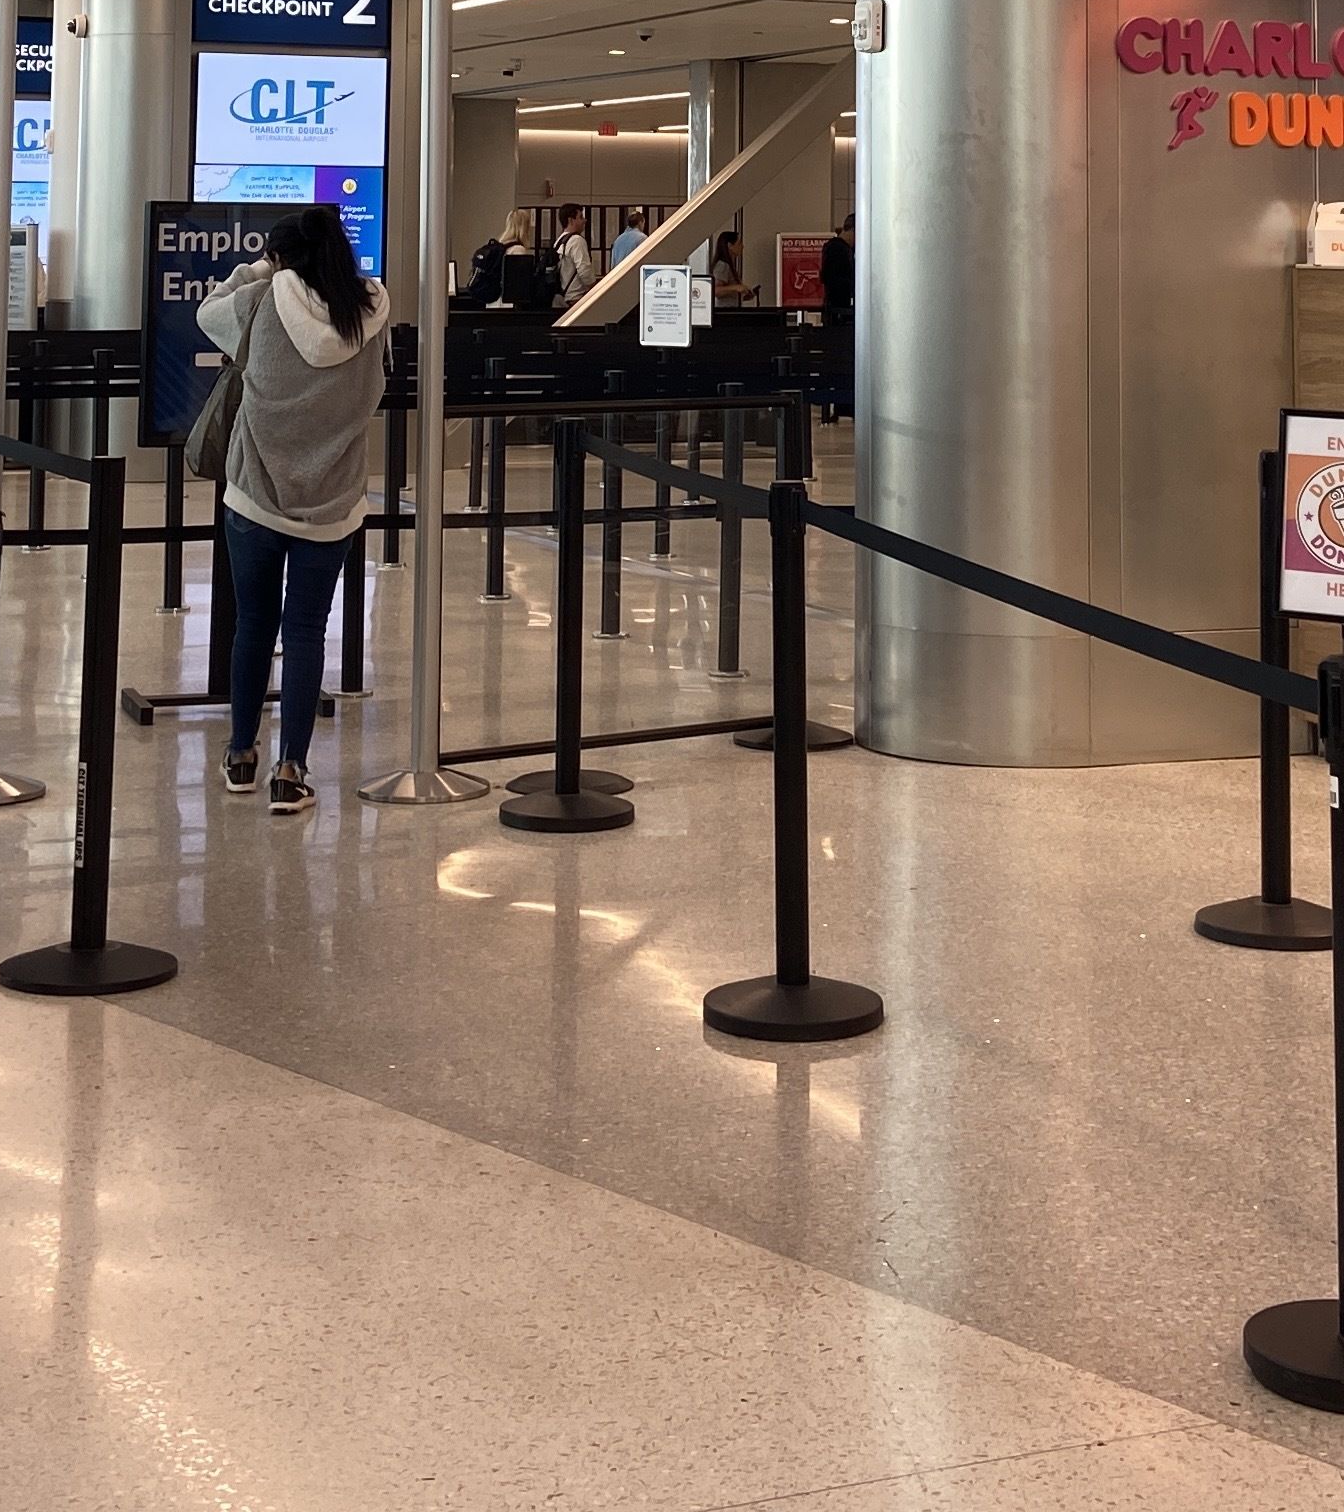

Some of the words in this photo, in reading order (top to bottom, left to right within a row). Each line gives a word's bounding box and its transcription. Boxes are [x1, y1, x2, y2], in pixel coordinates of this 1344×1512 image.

[15, 44, 54, 57] SECU
[250, 78, 336, 125] CLT
[250, 126, 294, 134] CHARLOTTE
[298, 126, 335, 135] DOUGLAS
[157, 221, 270, 261] Emplo
[163, 271, 216, 301] Ent
